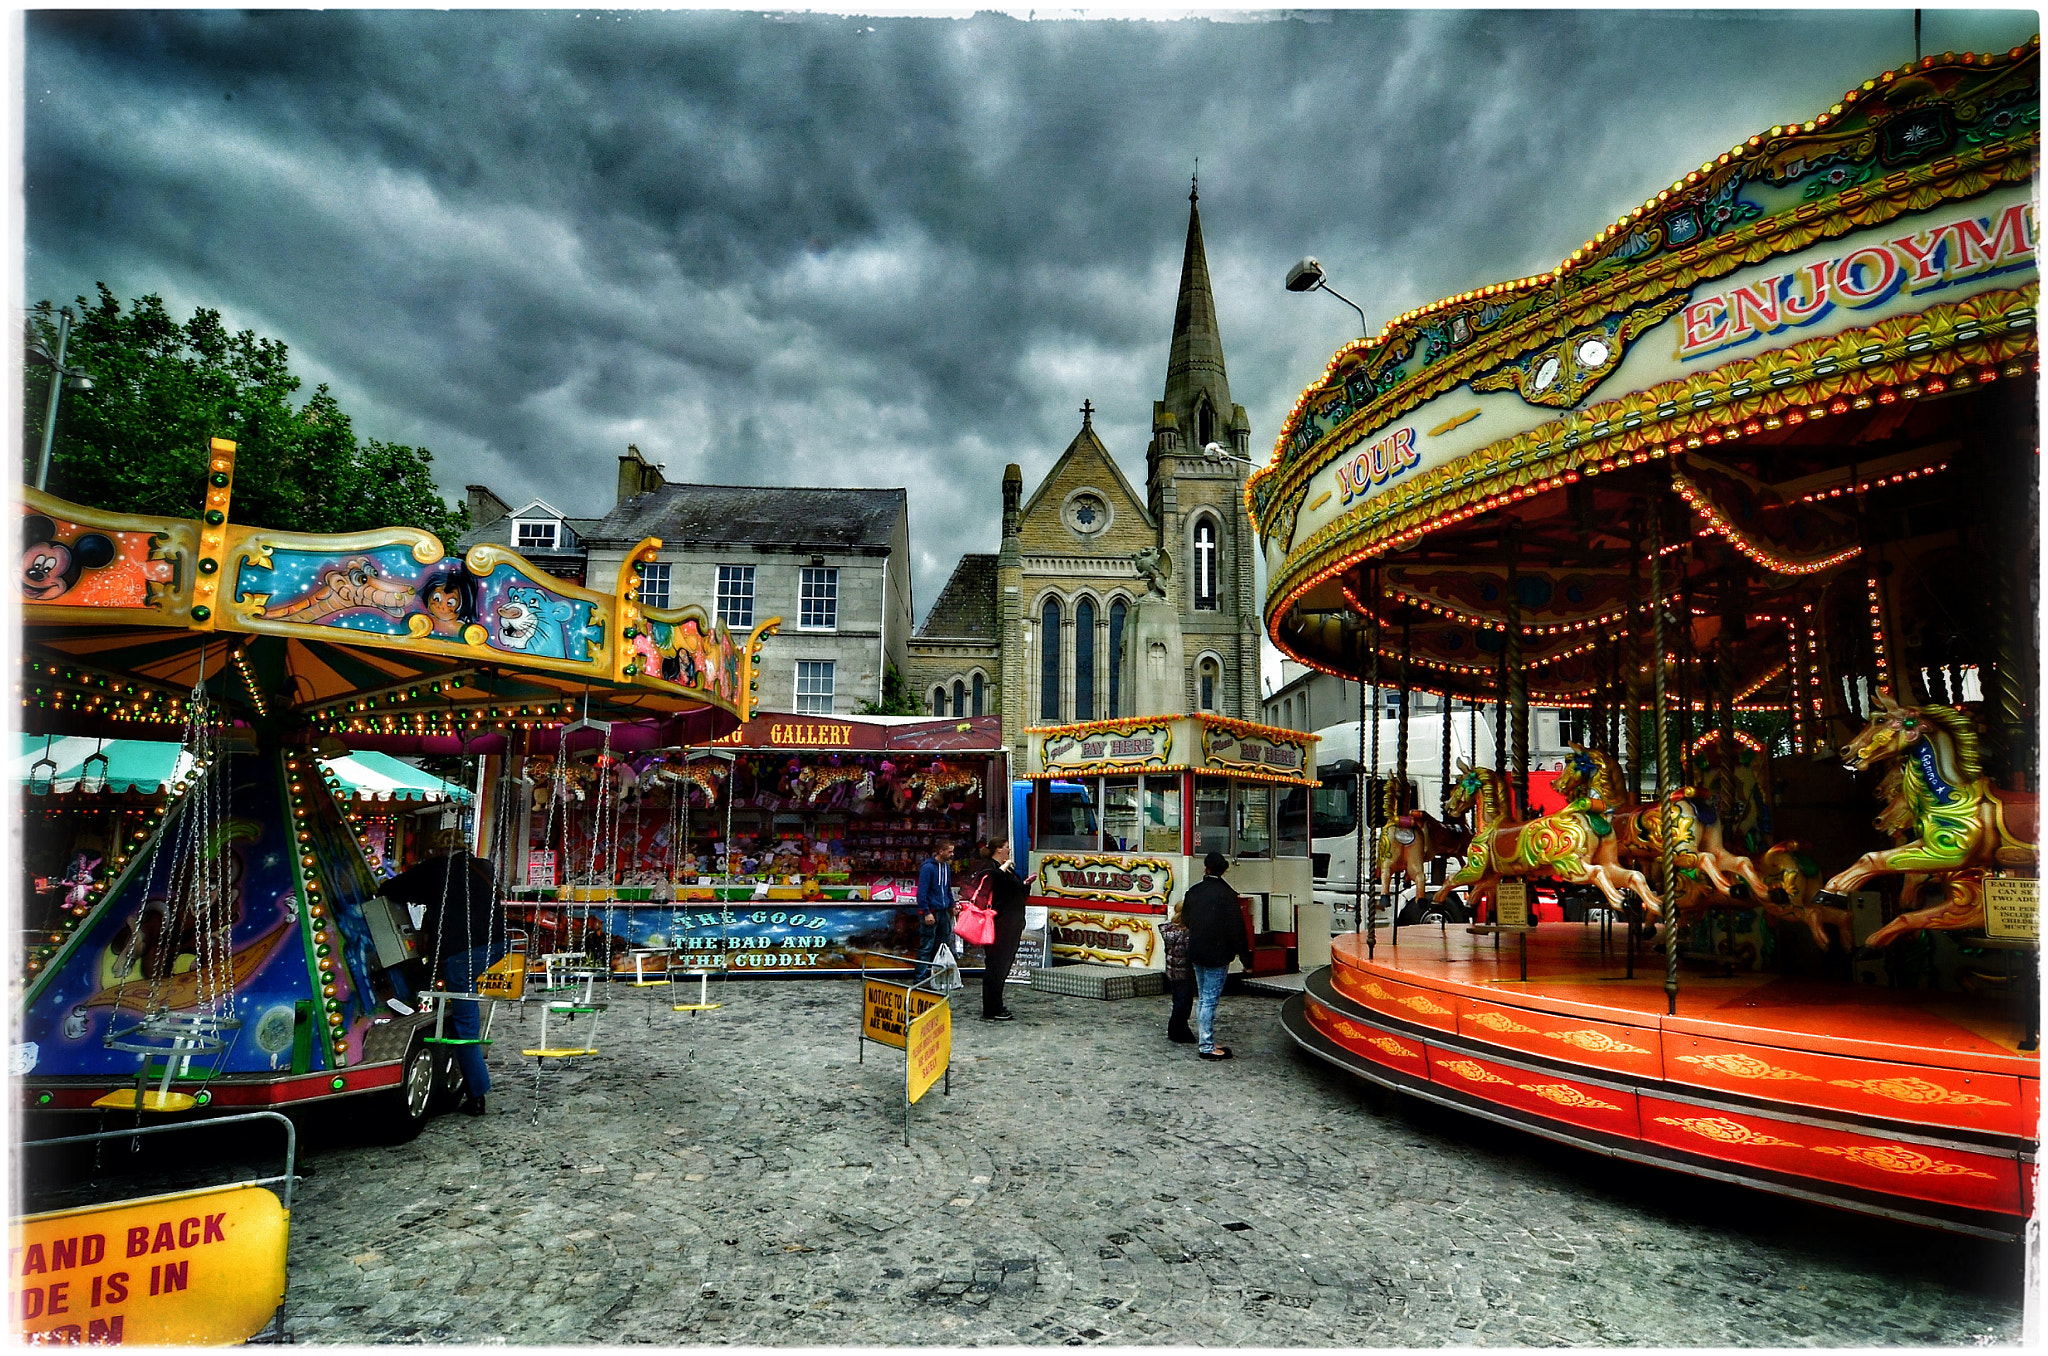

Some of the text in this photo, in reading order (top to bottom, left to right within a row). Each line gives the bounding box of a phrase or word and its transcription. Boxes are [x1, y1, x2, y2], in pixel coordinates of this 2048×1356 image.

[1680, 203, 2037, 355] ENJOYM
[1336, 426, 1418, 500] YOUR
[770, 723, 853, 745] GALLERY
[1082, 738, 1155, 757] PAY HERE
[1240, 743, 1297, 766] PAY HERE
[1921, 754, 1938, 785] Gemma
[1058, 870, 1154, 892] WALLIS'S
[674, 910, 828, 930] THE GOOD
[674, 935, 827, 949] THE BAD AND
[1051, 926, 1135, 952] AROUSEL
[679, 953, 820, 967] THE CUDDLY
[868, 987, 893, 1008] NOTICE
[894, 993, 902, 1010] TO
[126, 1212, 226, 1258] BACK
[90, 1272, 130, 1307] IS
[150, 1260, 189, 1296] IN
